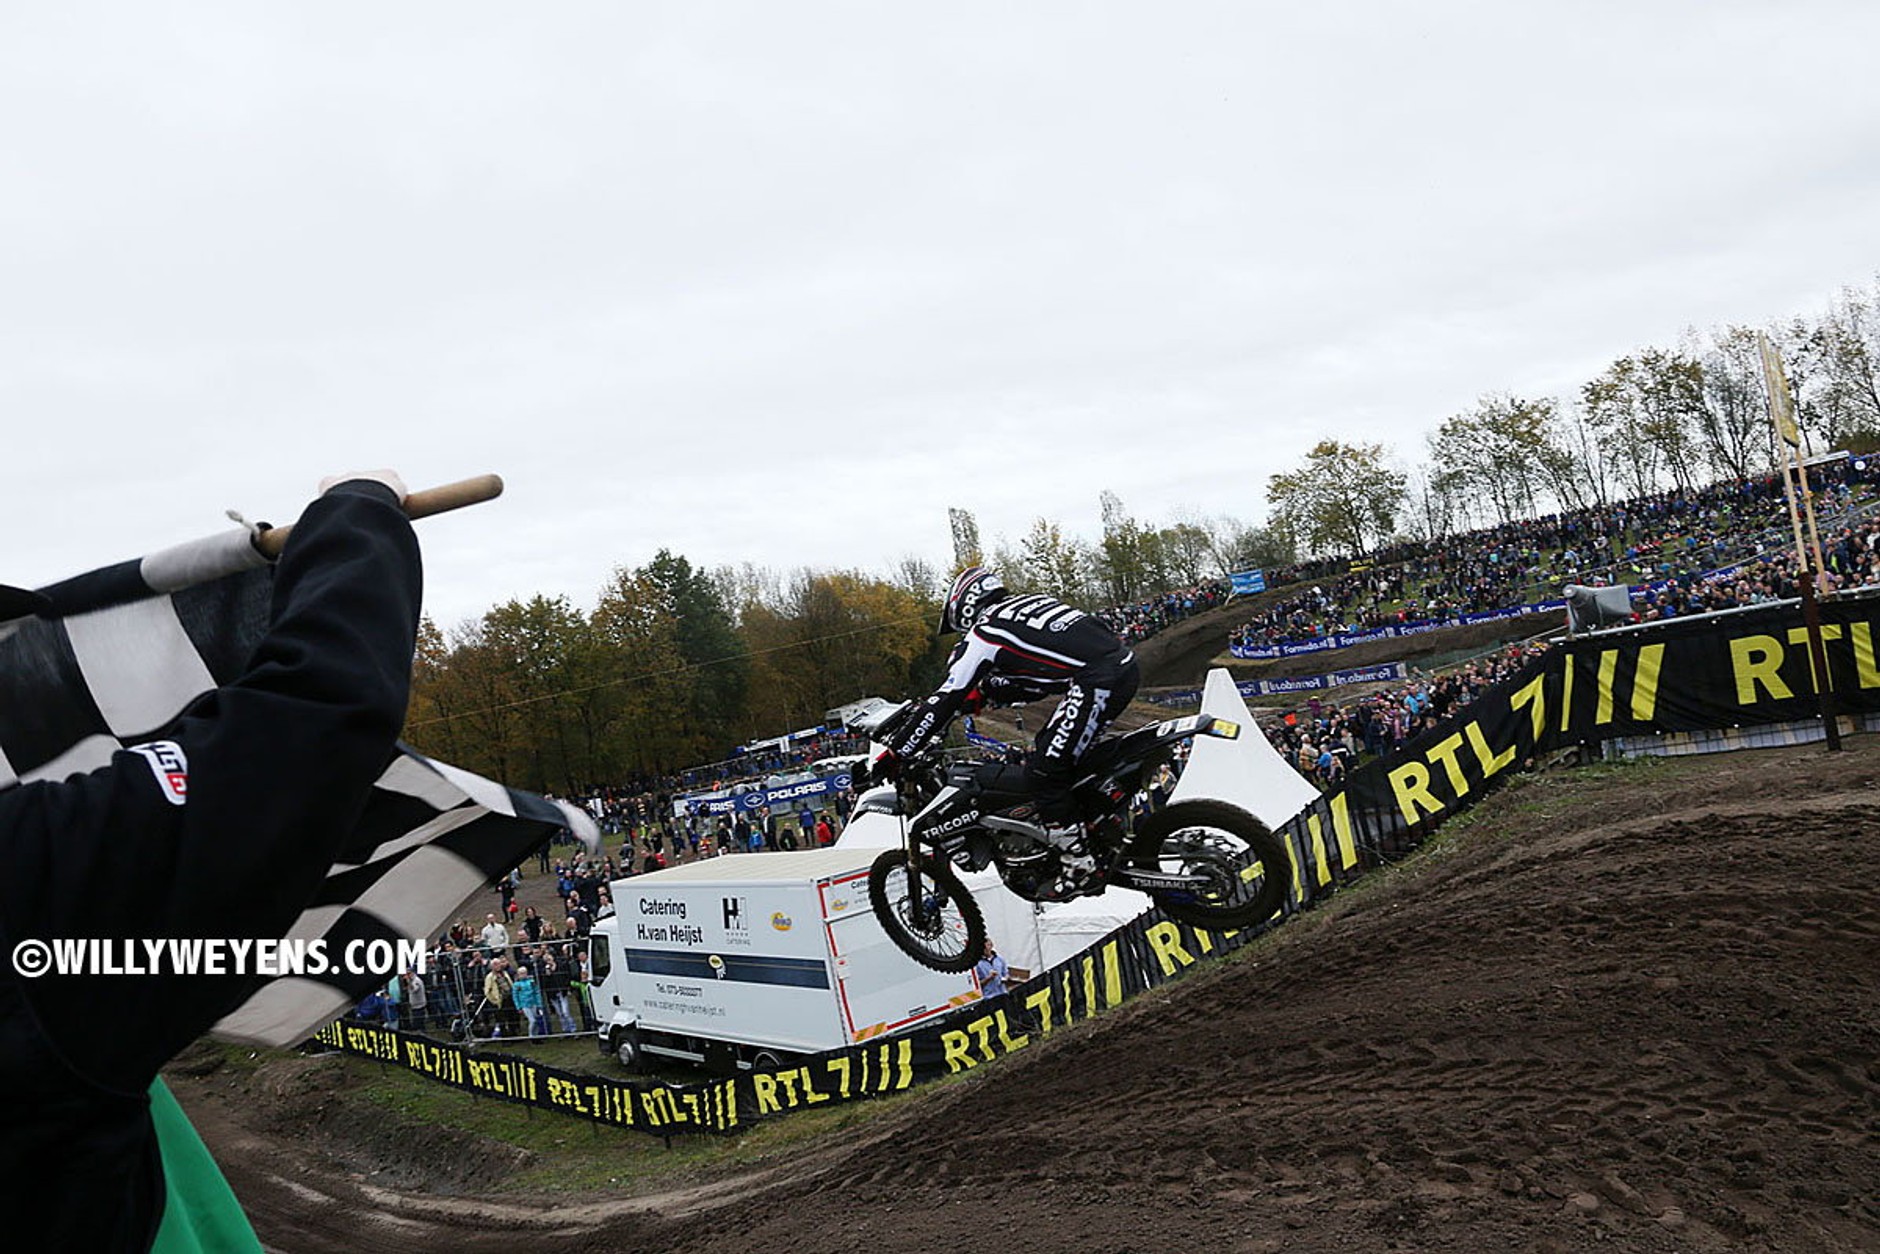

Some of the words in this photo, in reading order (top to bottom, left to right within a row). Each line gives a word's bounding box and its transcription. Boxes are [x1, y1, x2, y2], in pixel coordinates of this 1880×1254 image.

[767, 781, 827, 801] POLARIS
[921, 810, 980, 839] TRICORP
[639, 898, 686, 919] Catering
[669, 924, 703, 946] Heijst
